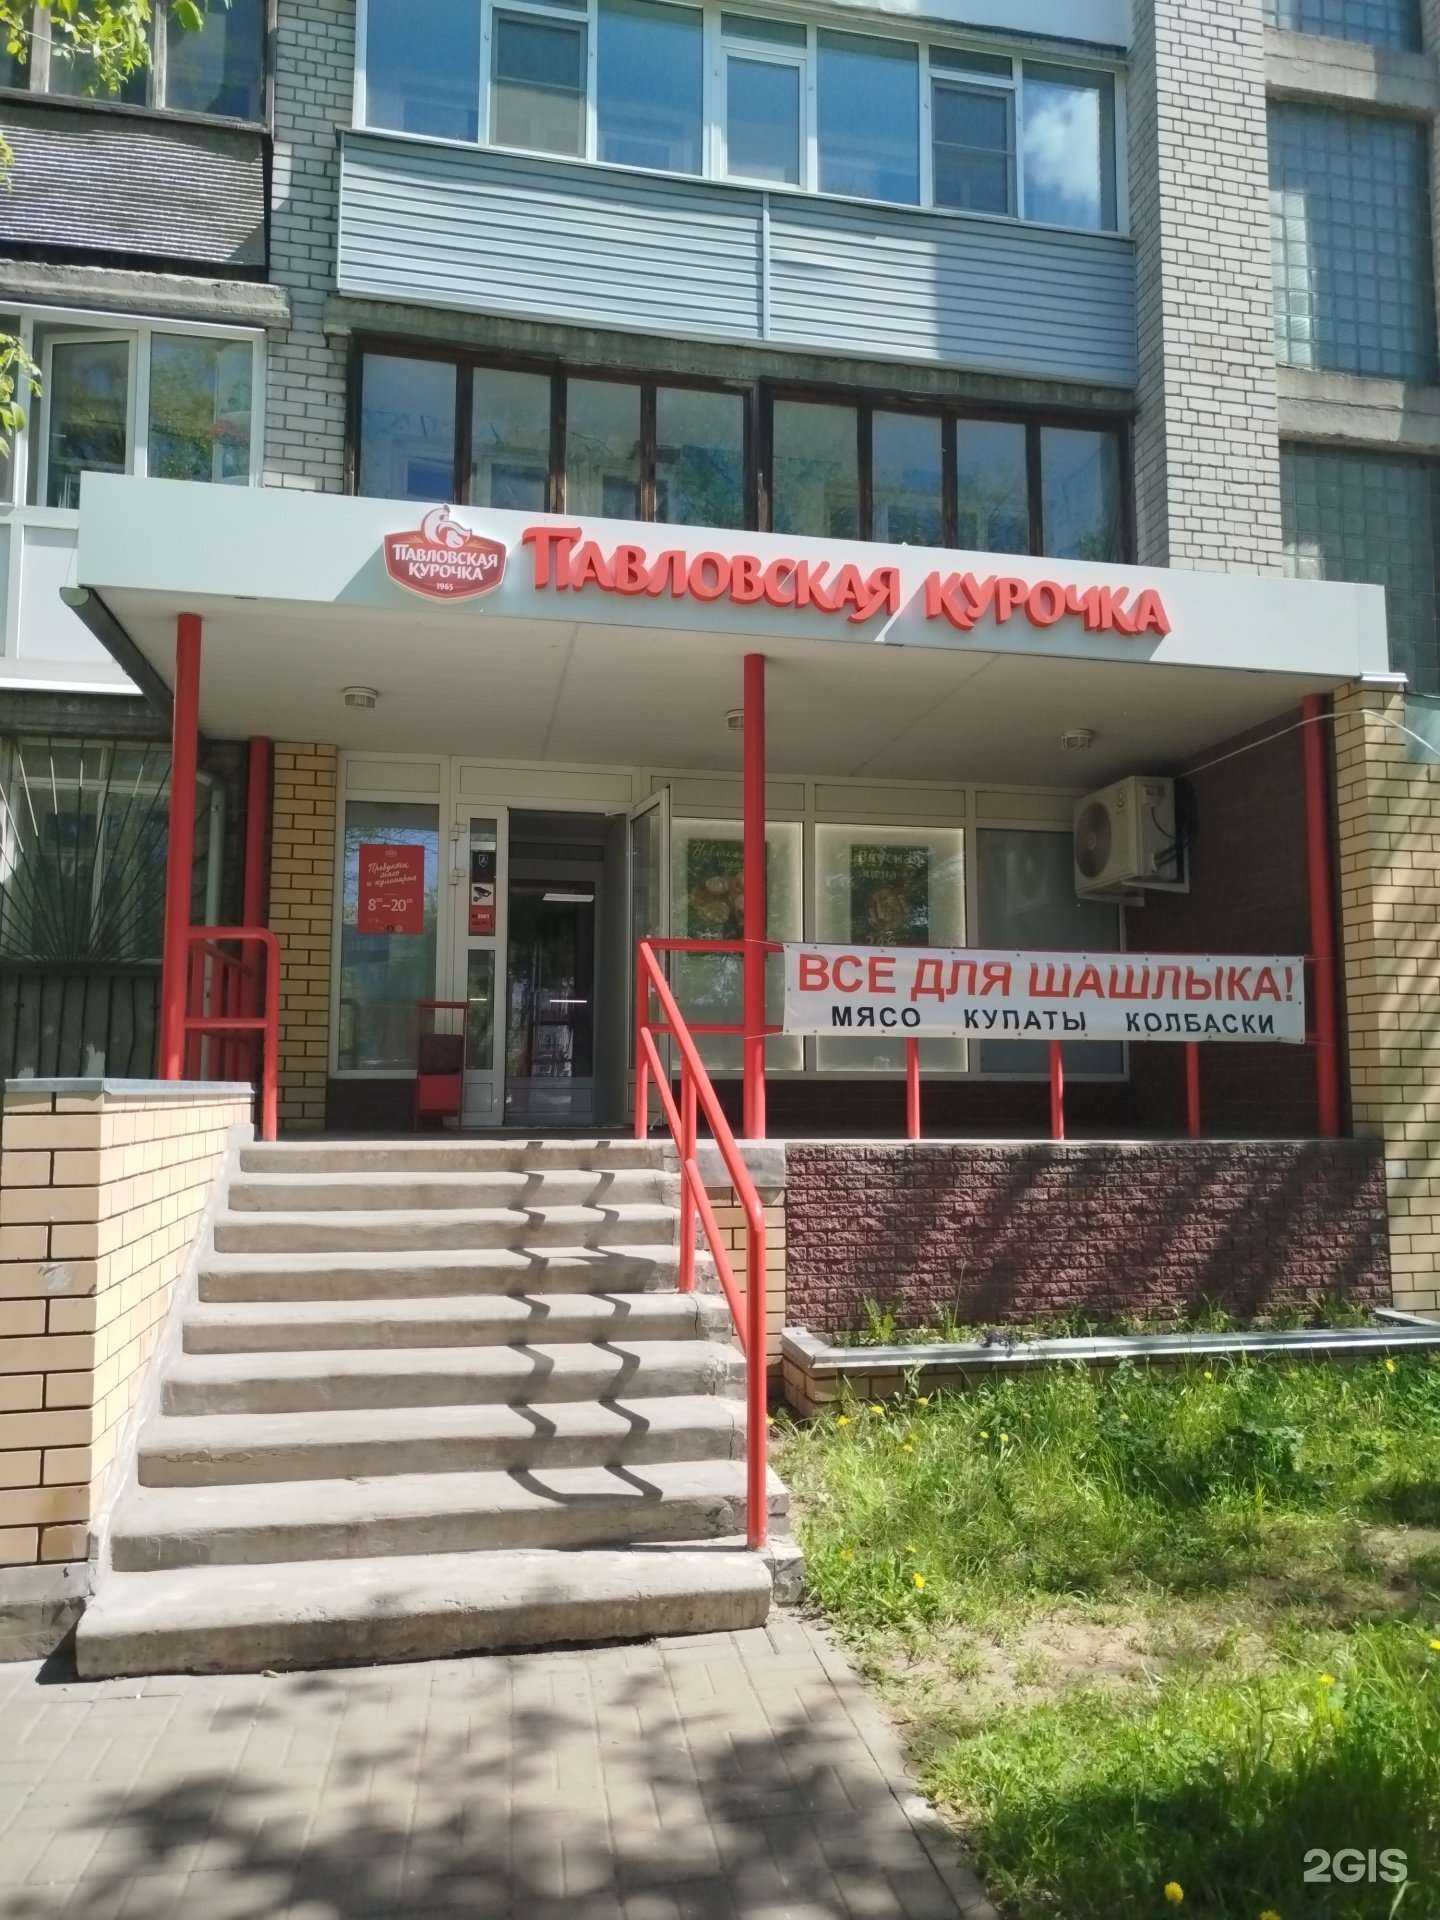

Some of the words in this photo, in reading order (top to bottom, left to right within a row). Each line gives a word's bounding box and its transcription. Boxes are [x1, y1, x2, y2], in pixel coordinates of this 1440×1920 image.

[392, 543, 498, 570] ПАВЛОВСКАЯ
[408, 562, 484, 581] КУРОЧКА
[522, 526, 902, 624] ПАВЛОВСКАЯ
[924, 570, 1172, 636] КУРОЧКА
[436, 582, 454, 591] 1965
[799, 953, 897, 994] ВСЕ
[910, 958, 1012, 1002] ДЛЯ
[1029, 962, 1293, 1002] ШАШЛЫКА!
[831, 1006, 921, 1028] МЯСО
[963, 1008, 1087, 1031] КУПАТЫ
[1126, 1012, 1275, 1034] КОЛБАСКИ
